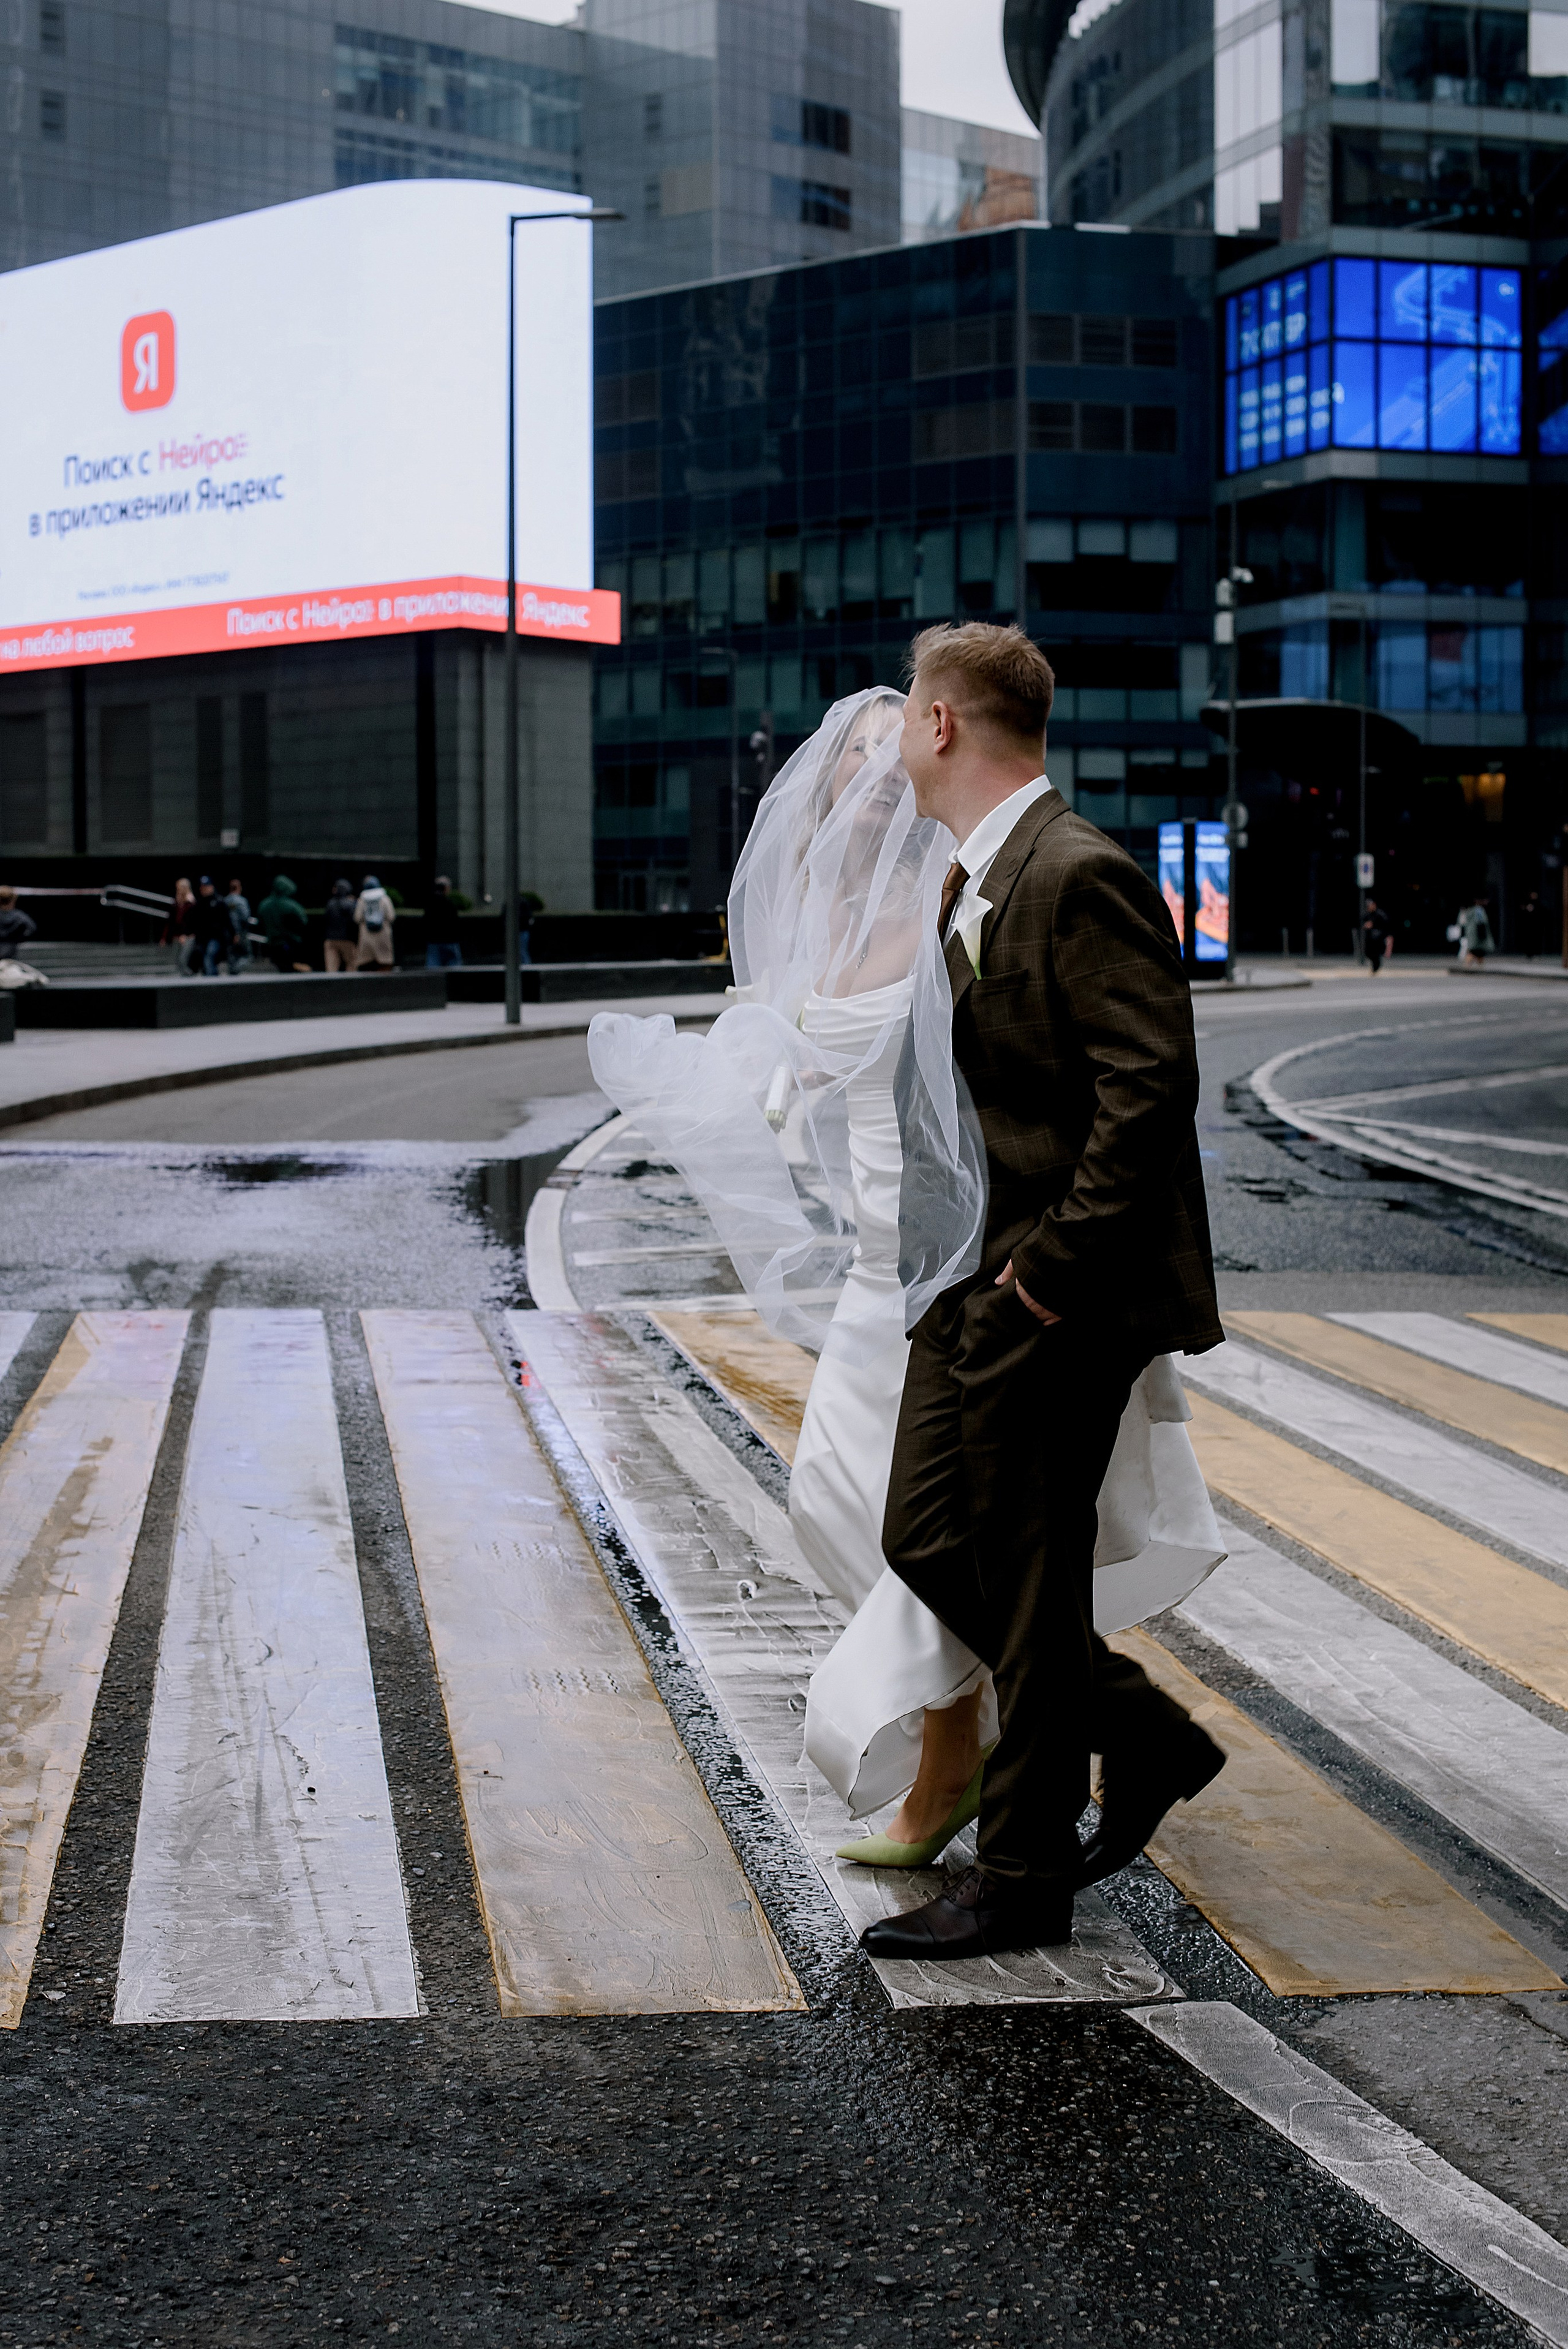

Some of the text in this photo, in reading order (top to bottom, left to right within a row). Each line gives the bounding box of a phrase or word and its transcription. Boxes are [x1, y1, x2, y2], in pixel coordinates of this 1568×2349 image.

[134, 331, 159, 393] Я
[64, 432, 239, 489] Поиск с Нейро
[29, 473, 285, 538] в приложении Яндекс
[227, 607, 284, 637] Поиск
[286, 607, 300, 630] с
[394, 590, 510, 624] приложени
[522, 592, 590, 629] Яндекс
